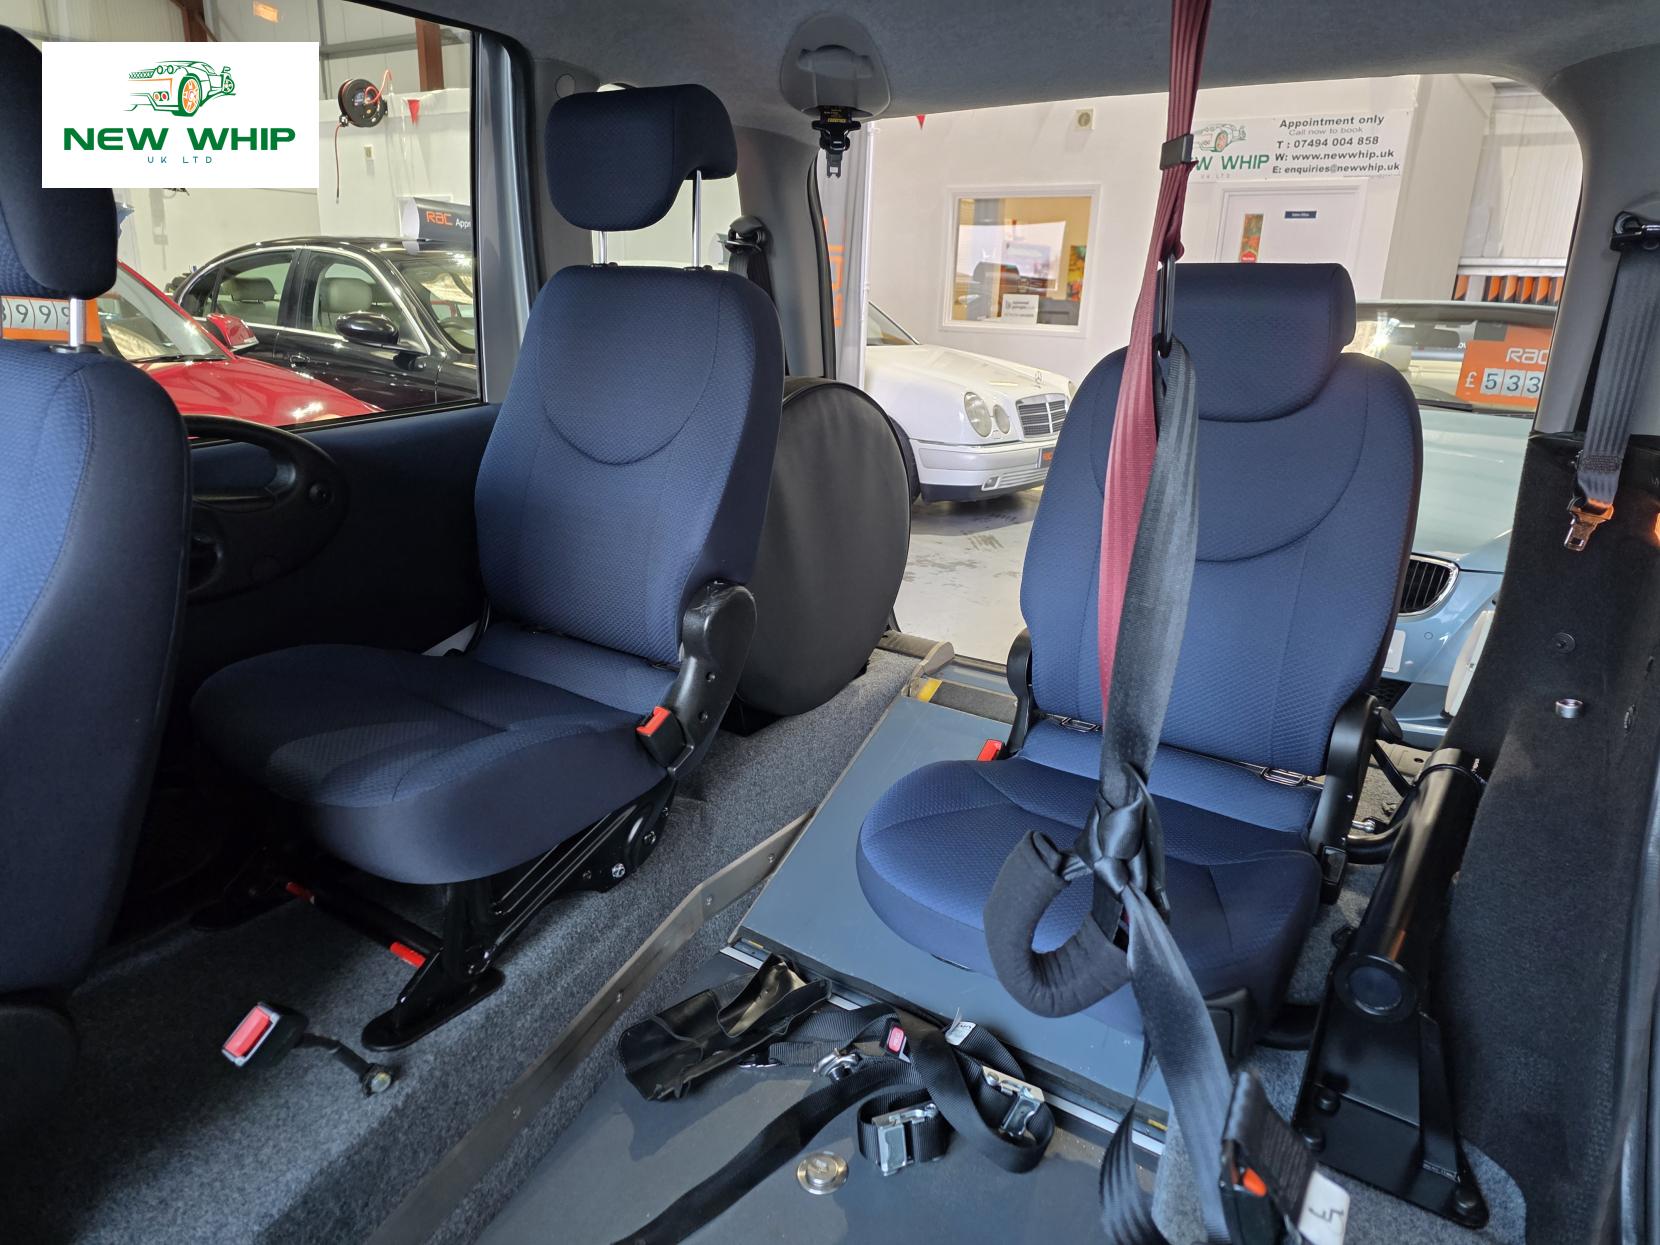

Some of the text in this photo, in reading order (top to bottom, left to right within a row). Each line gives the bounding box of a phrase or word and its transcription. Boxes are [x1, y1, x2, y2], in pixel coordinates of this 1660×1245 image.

[1280, 115, 1385, 129] Appointment only
[1288, 128, 1306, 136] Call
[1340, 126, 1363, 134] book
[1293, 139, 1328, 149] 07494
[1332, 137, 1353, 147] 004
[1357, 136, 1379, 146] 858
[1221, 154, 1269, 170] WHIP
[1275, 150, 1394, 161] W: www.newwhip.uk
[1284, 163, 1400, 175] enquiries@newwhip.uk
[1465, 372, 1477, 388] £
